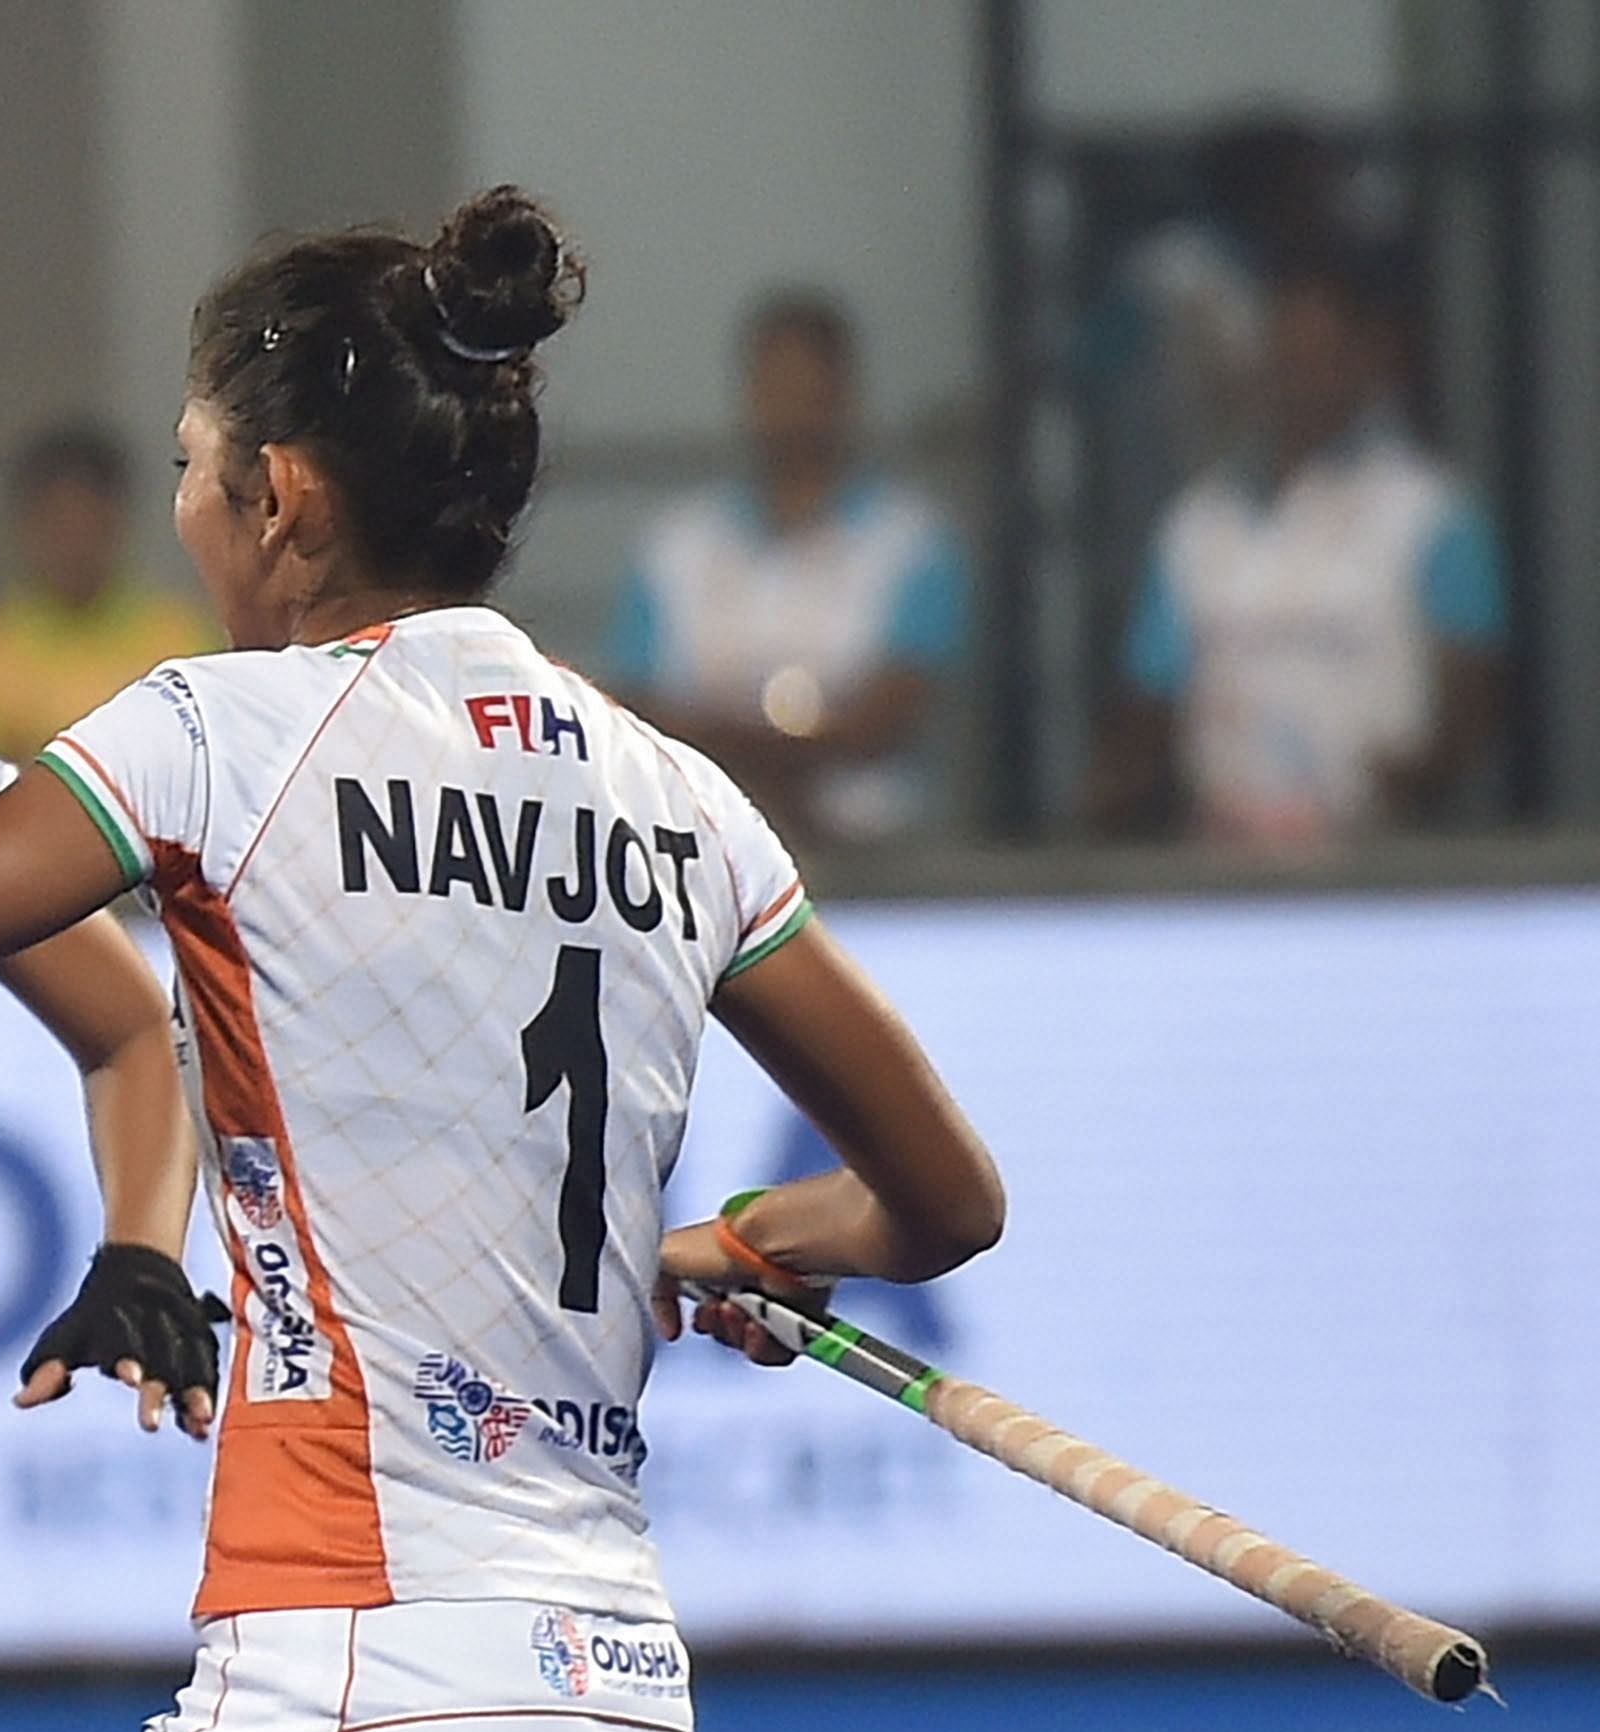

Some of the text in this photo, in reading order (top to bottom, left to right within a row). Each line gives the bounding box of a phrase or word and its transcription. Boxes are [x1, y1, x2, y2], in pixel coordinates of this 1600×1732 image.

[464, 694, 589, 761] FIH
[335, 777, 699, 941] NAVJOT
[520, 945, 608, 1314] 1
[591, 1635, 684, 1678] ODISHA
